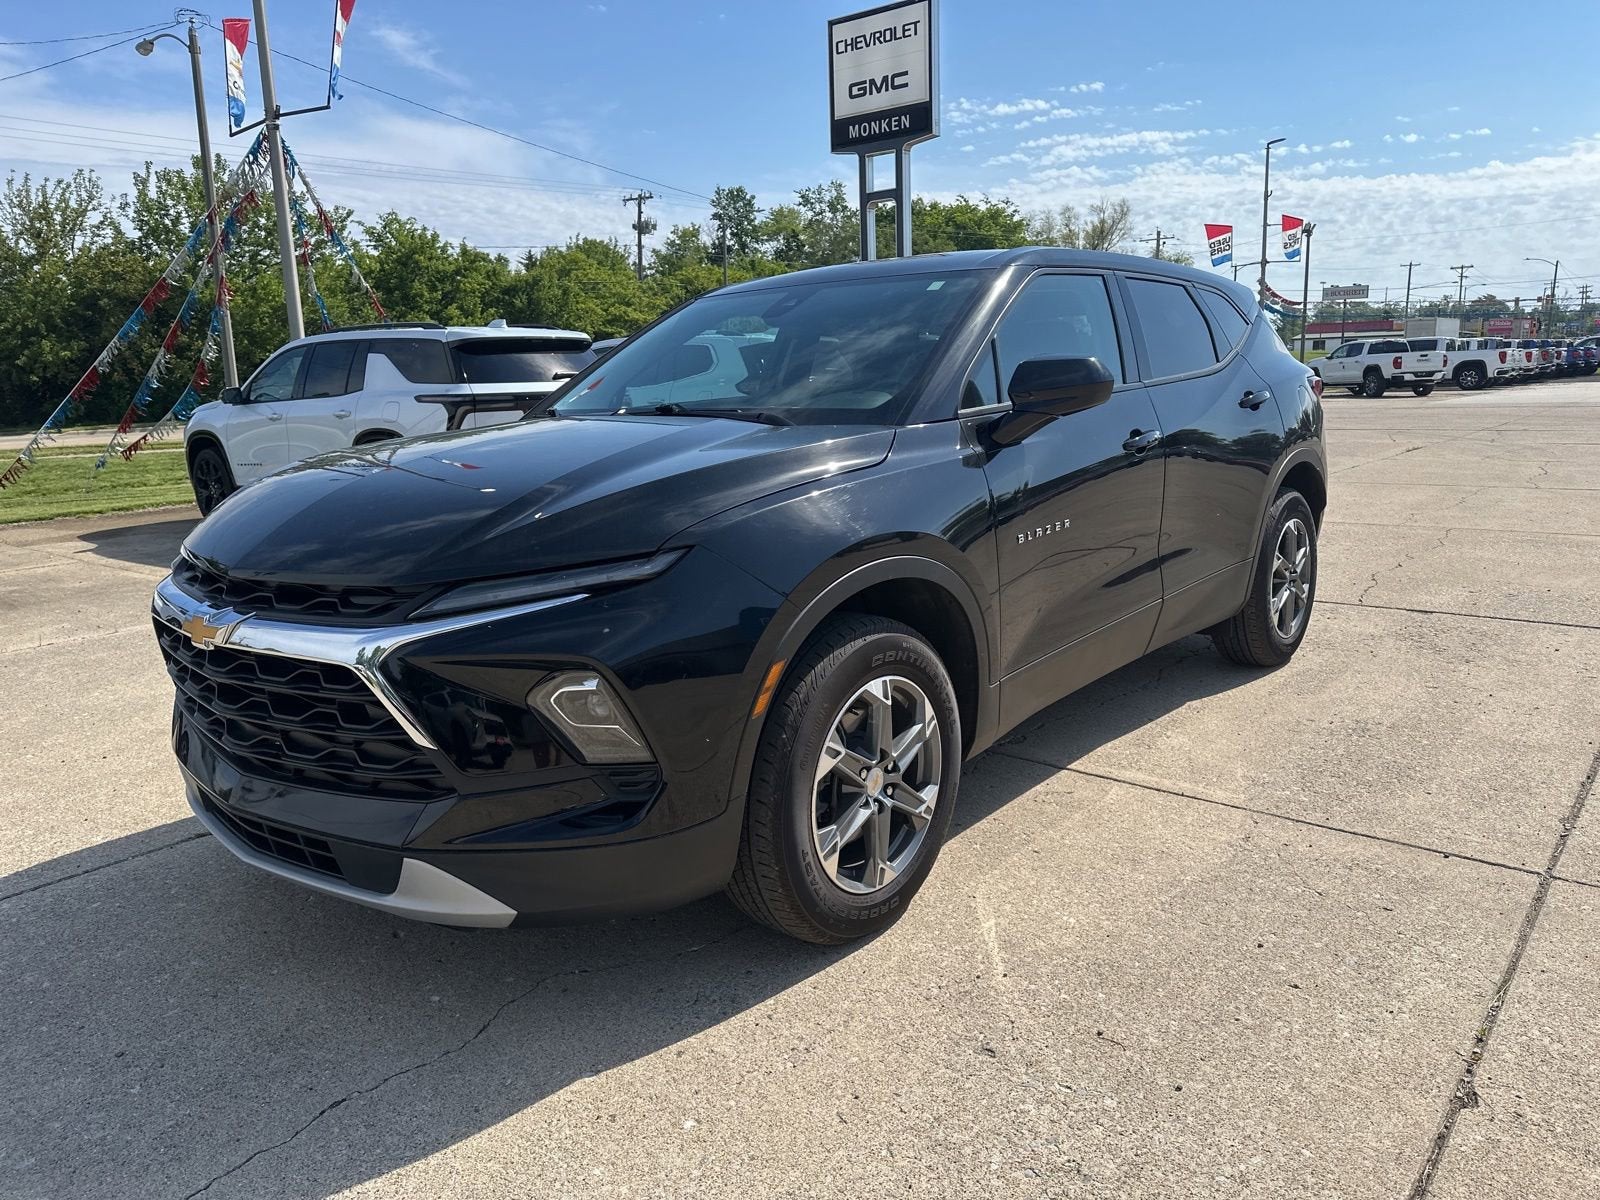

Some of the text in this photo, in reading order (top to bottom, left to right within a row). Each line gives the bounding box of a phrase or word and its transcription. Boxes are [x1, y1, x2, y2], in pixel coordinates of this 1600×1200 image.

[835, 20, 921, 55] CHEVROLET
[848, 70, 909, 99] GMC
[849, 114, 910, 139] MONKEN
[1017, 519, 1071, 544] BLAZER
